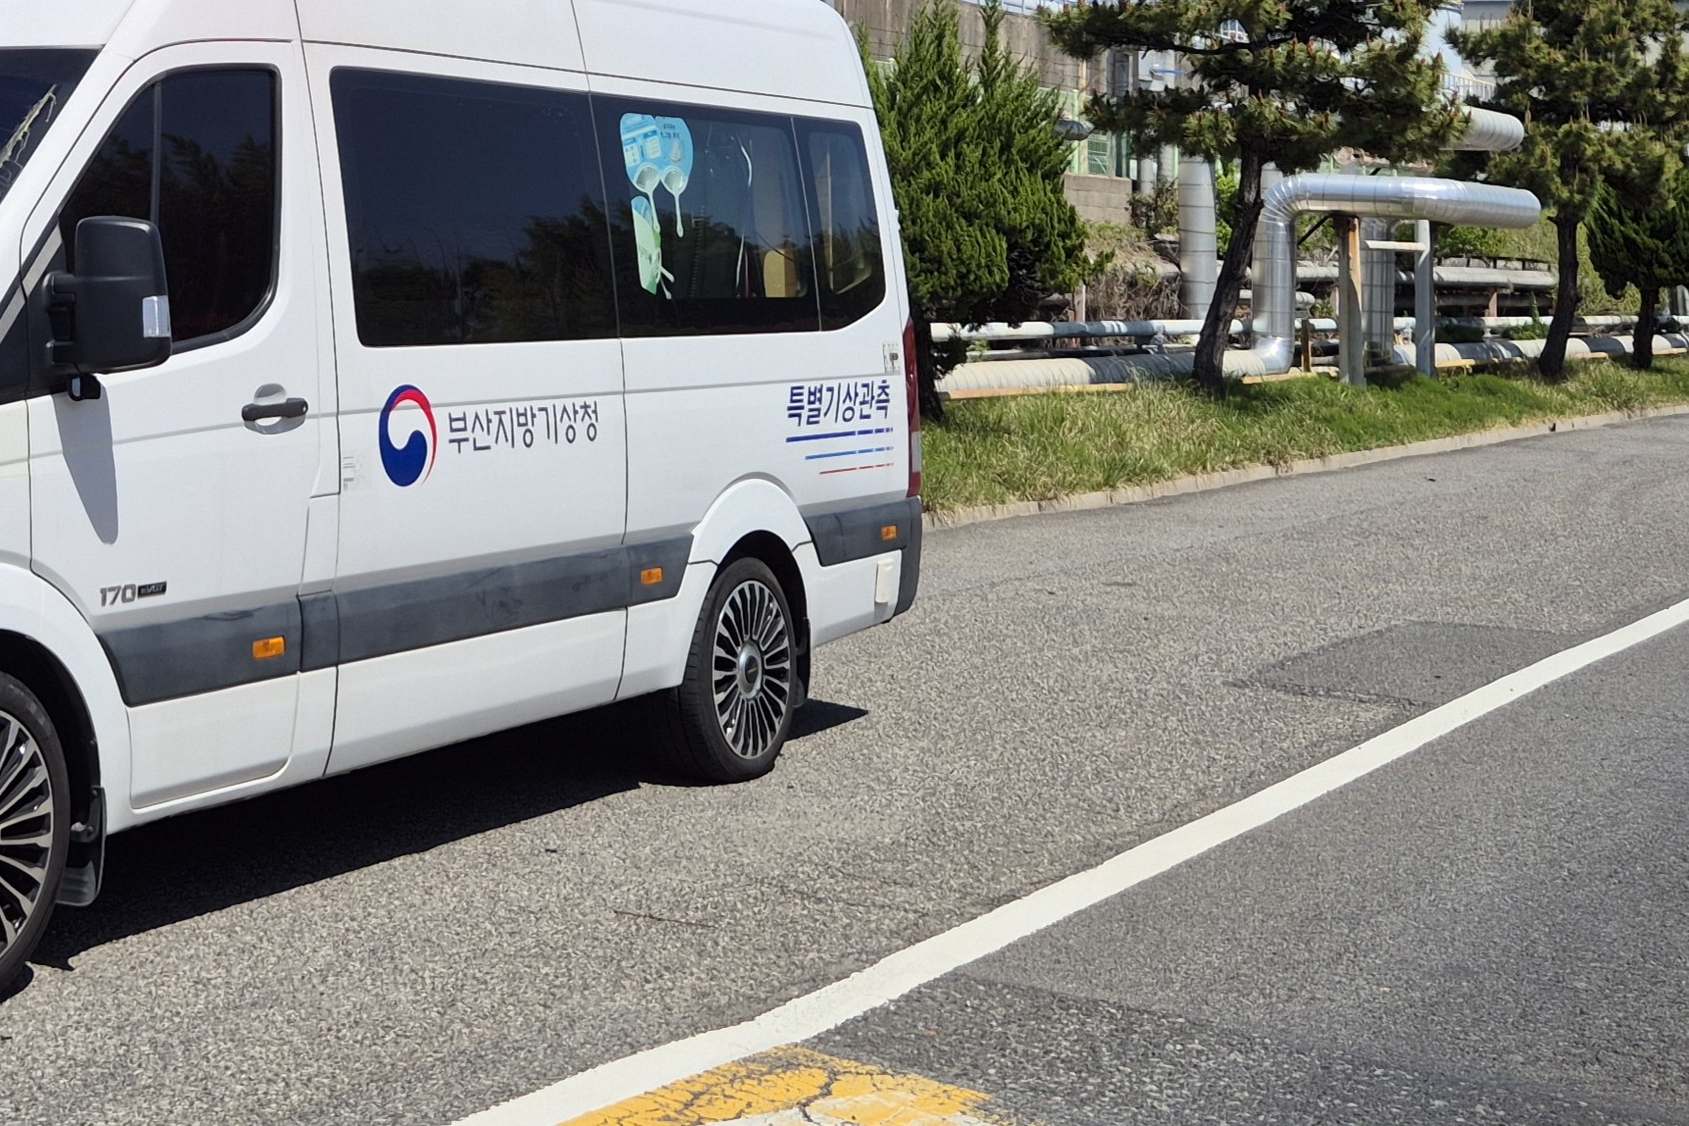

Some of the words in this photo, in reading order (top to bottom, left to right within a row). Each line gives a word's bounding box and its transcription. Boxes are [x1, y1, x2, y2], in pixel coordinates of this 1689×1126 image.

[448, 400, 599, 454] 부산지방기상청
[787, 379, 891, 427] 특별기상관측
[100, 583, 137, 607] 170
